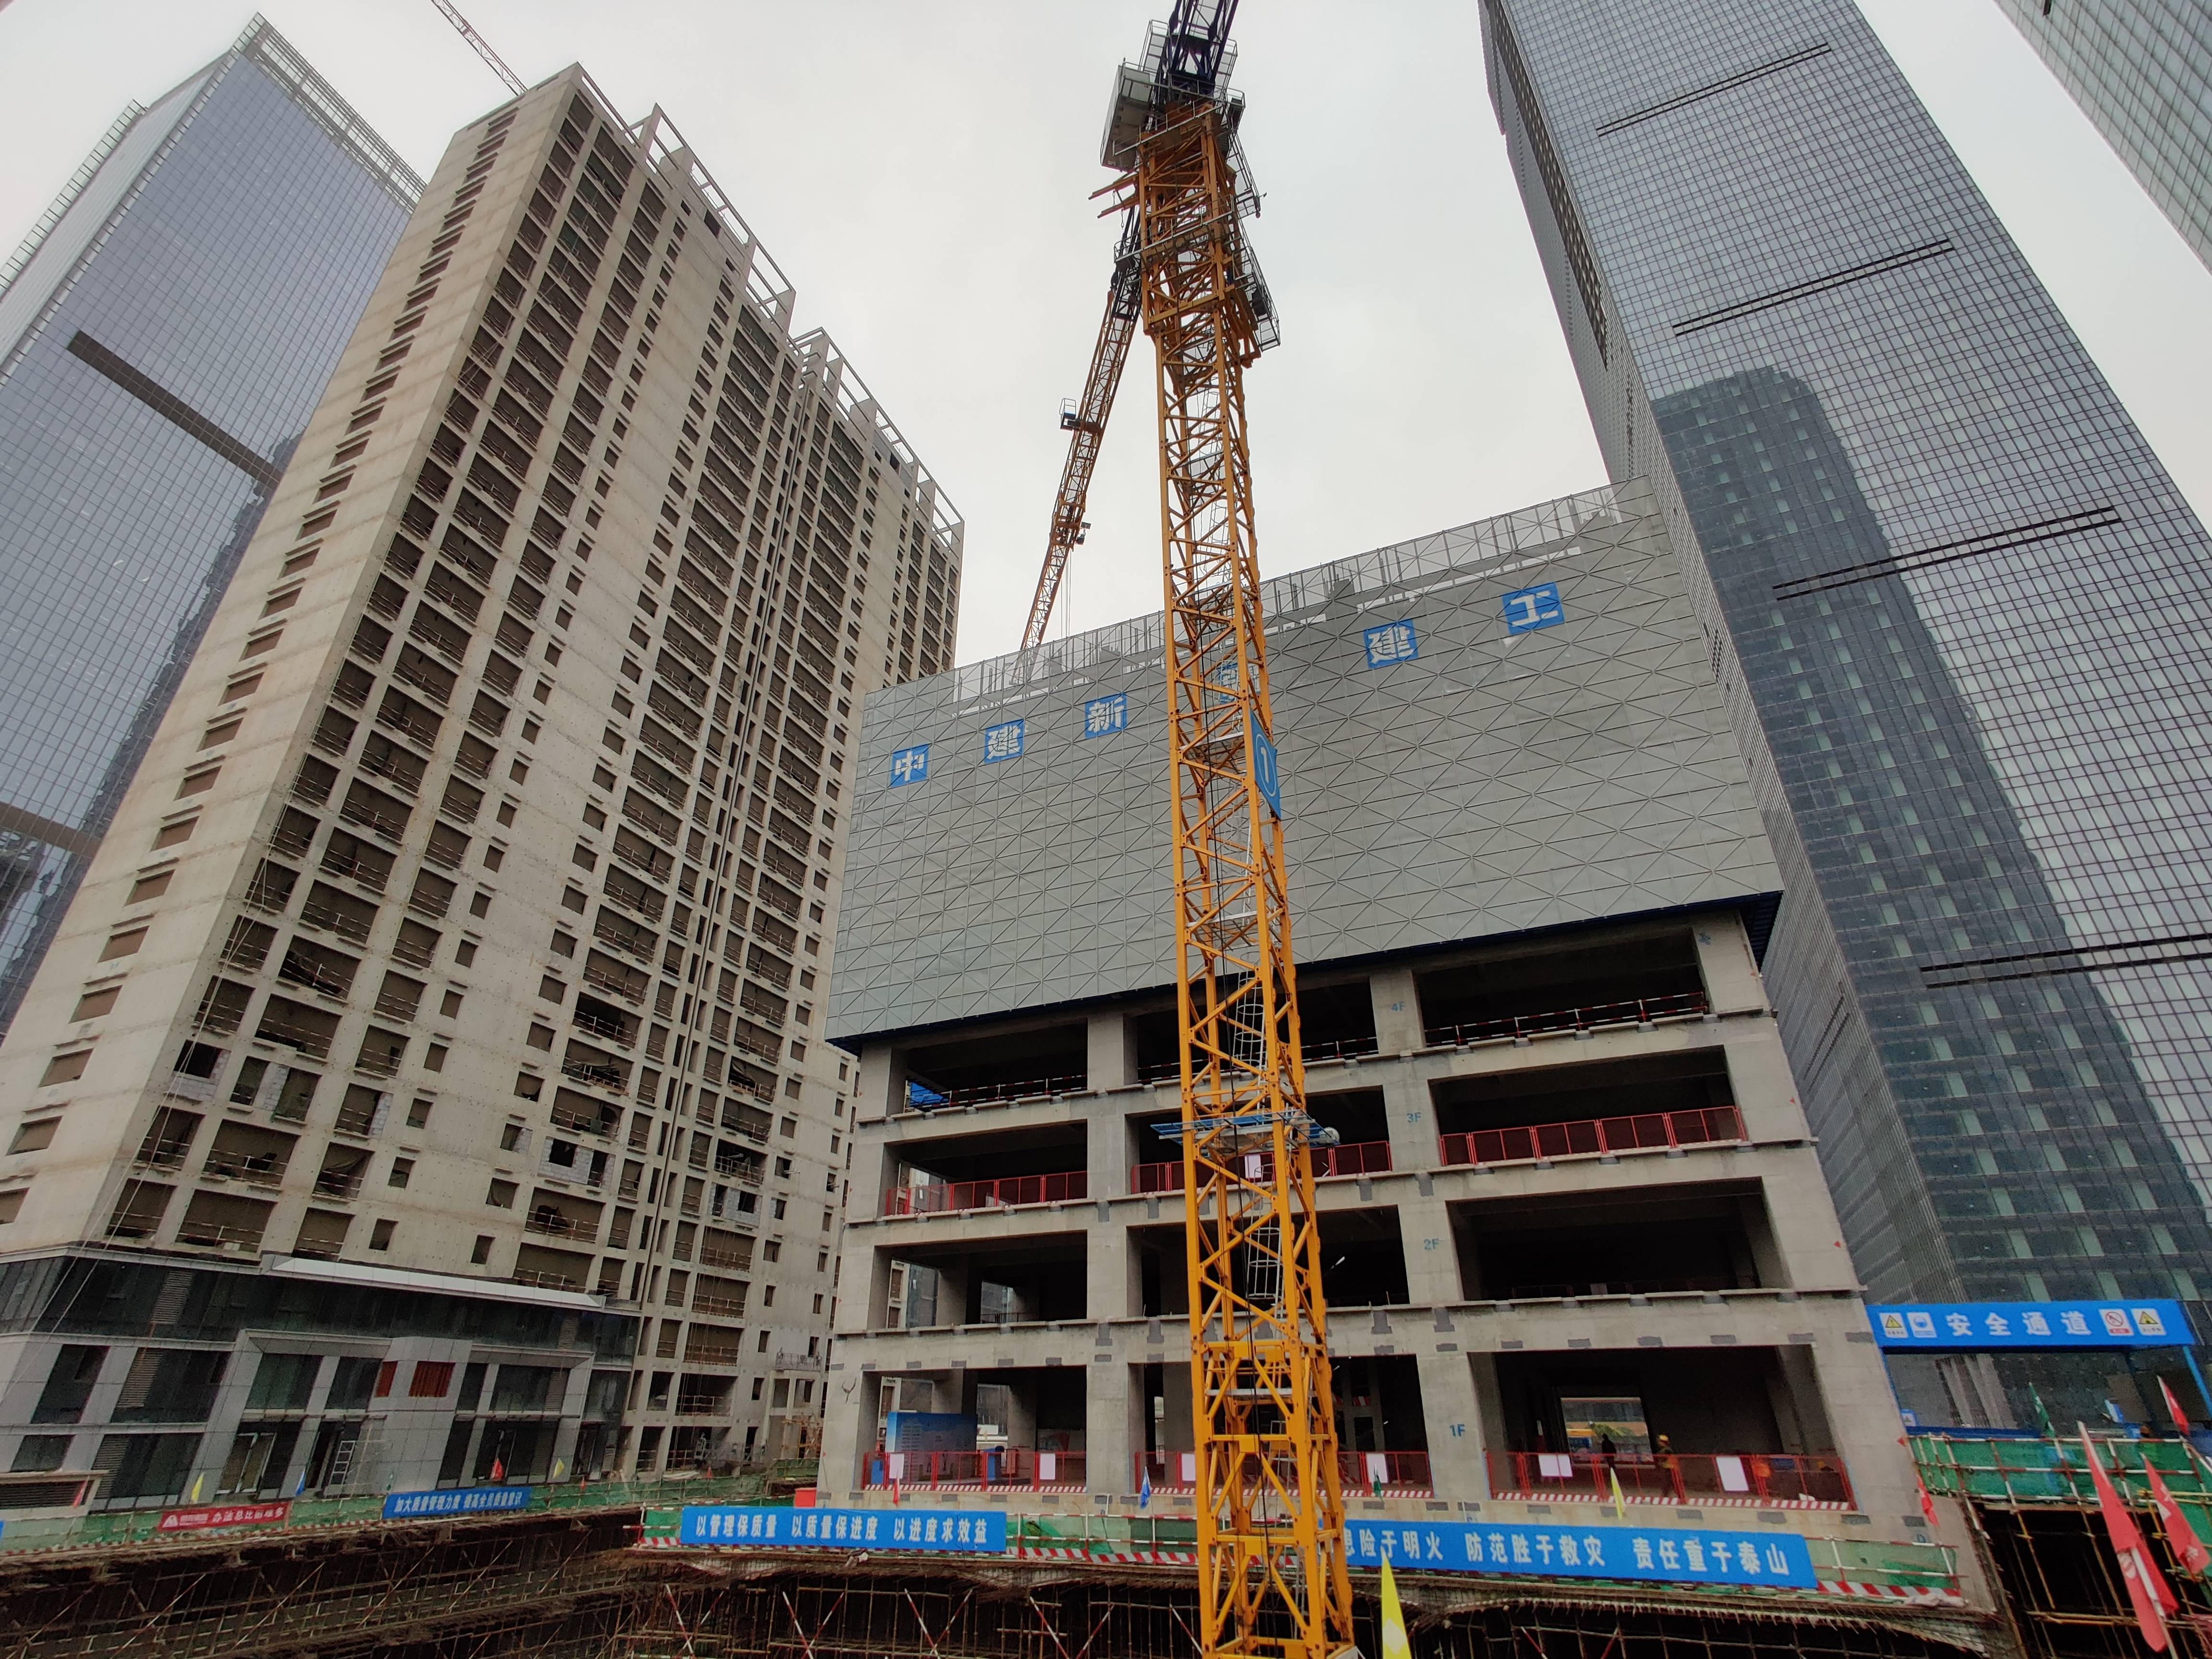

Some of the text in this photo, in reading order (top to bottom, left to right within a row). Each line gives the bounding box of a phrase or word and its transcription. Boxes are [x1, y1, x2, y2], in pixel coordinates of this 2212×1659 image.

[1407, 1111, 1421, 1123] 3F
[1423, 1238, 1440, 1250] 2F
[1946, 1311, 2092, 1336] 安全通道
[1449, 1424, 1466, 1437] 1F
[696, 1514, 987, 1544] 以管理保质量 以质量保进度 以进度求效益
[1465, 1532, 1605, 1567] 防范胜于救灾
[1632, 1537, 1790, 1575] 责任重于泰山
